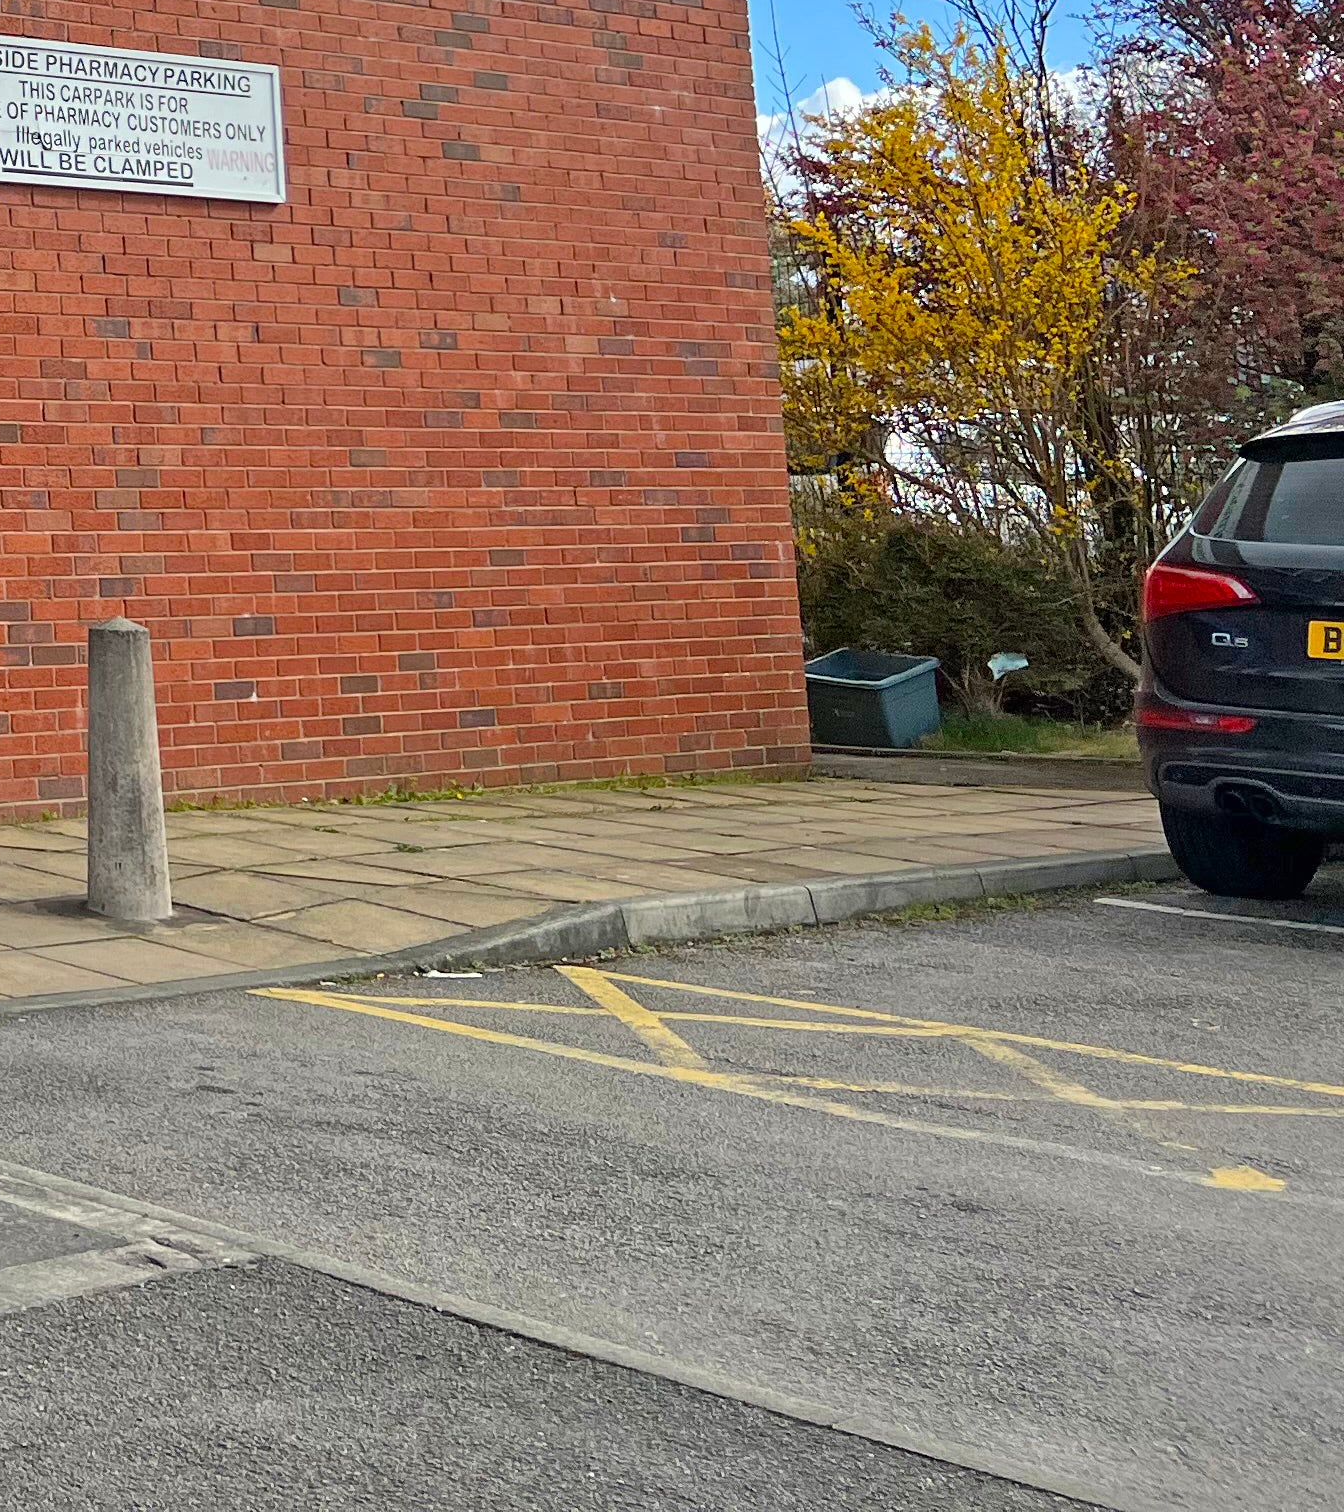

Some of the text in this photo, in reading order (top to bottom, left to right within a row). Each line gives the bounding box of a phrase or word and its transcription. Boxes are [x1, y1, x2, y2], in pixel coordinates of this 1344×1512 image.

[46, 54, 160, 83] PHARMACY
[164, 68, 251, 93] PARKING
[18, 80, 189, 115] THIS CARPARK IS FOR
[7, 102, 29, 120] OF
[34, 104, 121, 129] PHARMACY
[127, 113, 221, 139] CUSTOMERS
[225, 123, 266, 143] ONLY
[0, 147, 193, 180] WILL BE CLAMPED
[16, 125, 80, 153] Illegally
[89, 134, 140, 155] parked
[144, 139, 203, 160] vehicles
[207, 147, 275, 174] WARNING
[1211, 632, 1249, 648] Q5
